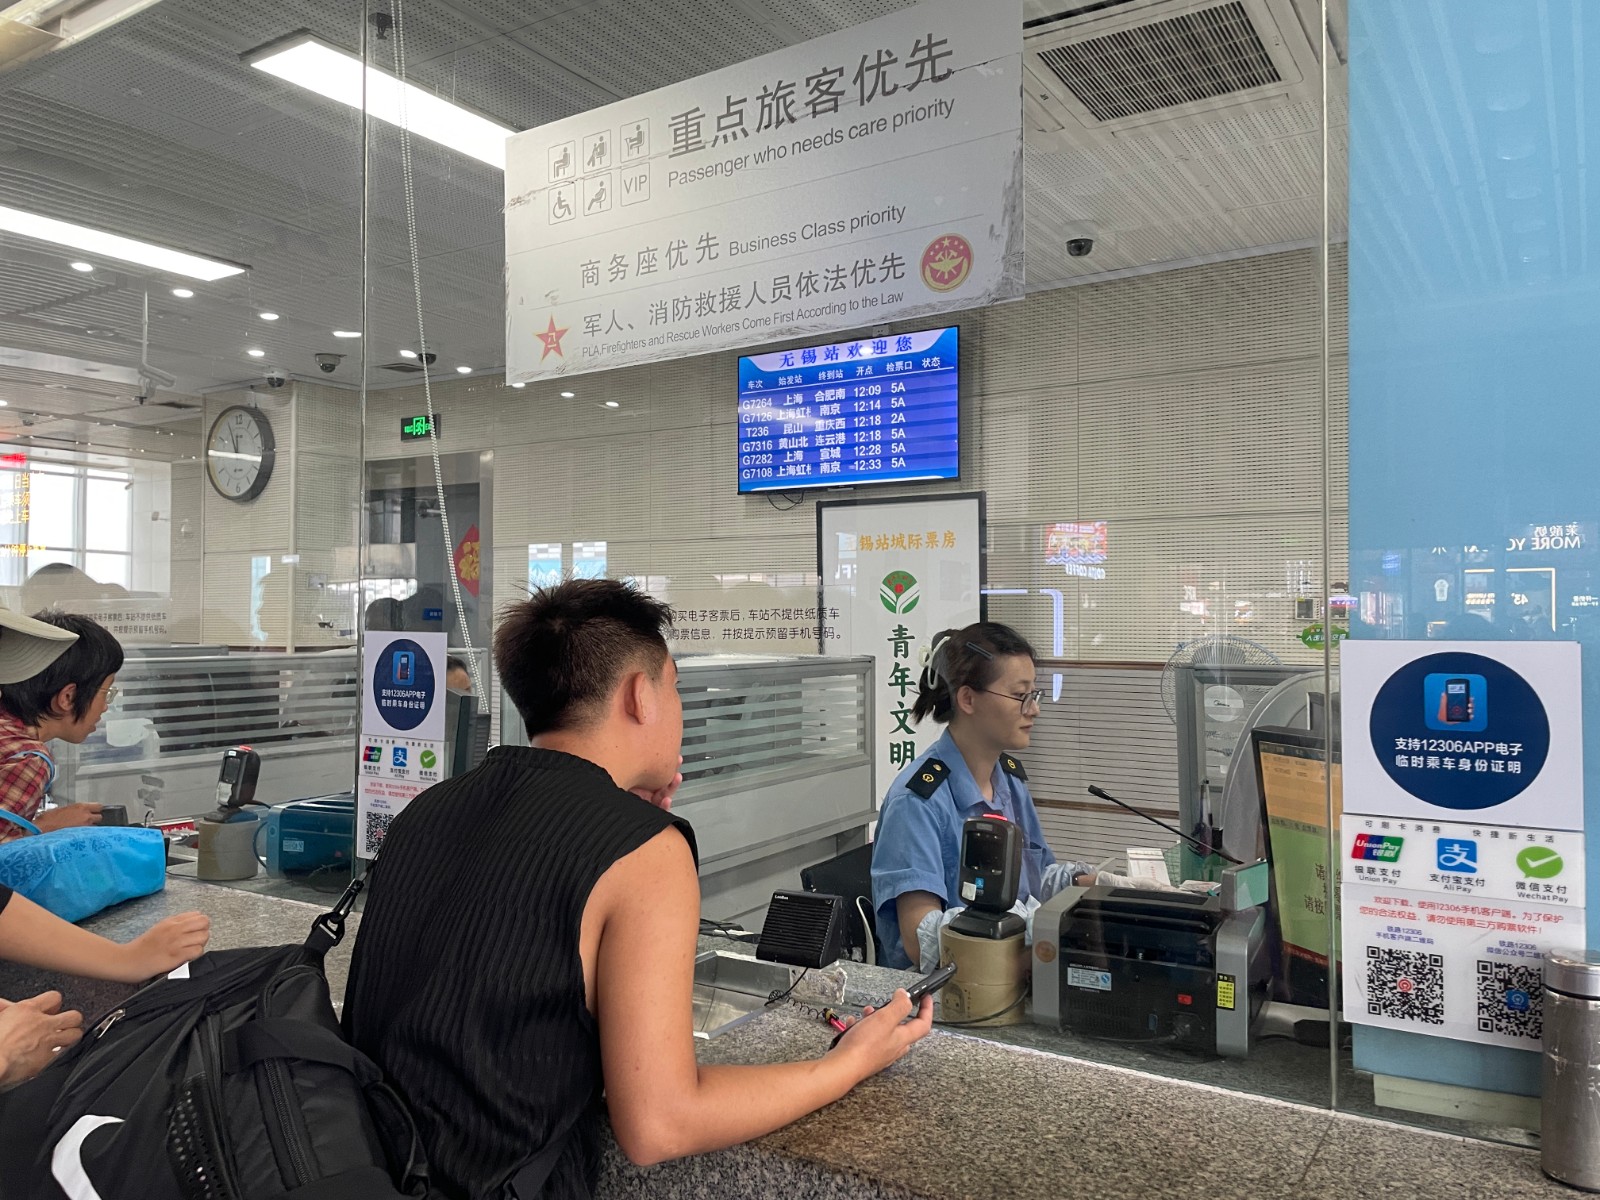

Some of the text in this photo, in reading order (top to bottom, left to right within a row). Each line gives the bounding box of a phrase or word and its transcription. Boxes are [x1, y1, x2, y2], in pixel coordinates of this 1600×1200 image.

[667, 33, 953, 159] 重点旅客优先
[668, 98, 955, 187] Passenger who needs care priority
[623, 174, 648, 194] VIP
[729, 206, 906, 257] Business Class priority
[580, 232, 720, 289] 商务座优先
[583, 252, 906, 338] 军人、消防救援人员依法优先
[648, 334, 665, 346] and
[667, 328, 700, 343] Rescue
[702, 321, 740, 337] Workers
[742, 315, 771, 330] Come
[773, 310, 795, 325] First
[796, 302, 847, 320] According
[849, 300, 859, 311] to
[861, 296, 878, 309] the
[880, 290, 904, 306] Law
[779, 336, 912, 368] 无锡站欢迎您
[748, 356, 941, 389] 车次 始发站 终到站 开点 检票口 状态
[742, 383, 906, 410] G7264 上海 合肥南 12:09 5A
[742, 412, 773, 423] G7126
[820, 403, 840, 416] 南京
[854, 400, 881, 412] 12:14
[891, 397, 906, 408] 5A
[746, 412, 906, 437] T236 昆山 重庆西 12:18 2A
[742, 428, 906, 452] G7316 黄山北 连云港 12:18 5A
[742, 443, 906, 465] G7282 上海 宣城 12:28 5A
[742, 467, 773, 479] G7108
[820, 461, 840, 474] 南京
[854, 459, 881, 471] 12:33
[891, 458, 906, 468] 5A
[859, 530, 956, 551] 锡站城际票房
[887, 624, 916, 770] 青年文明
[1394, 737, 1523, 756] 支持12306APP电子
[1395, 754, 1522, 774] 临时乘车身份证明
[1354, 865, 1402, 878] 银联支付
[1429, 873, 1486, 887] 支付宝支付
[1515, 881, 1567, 895] 微信支付
